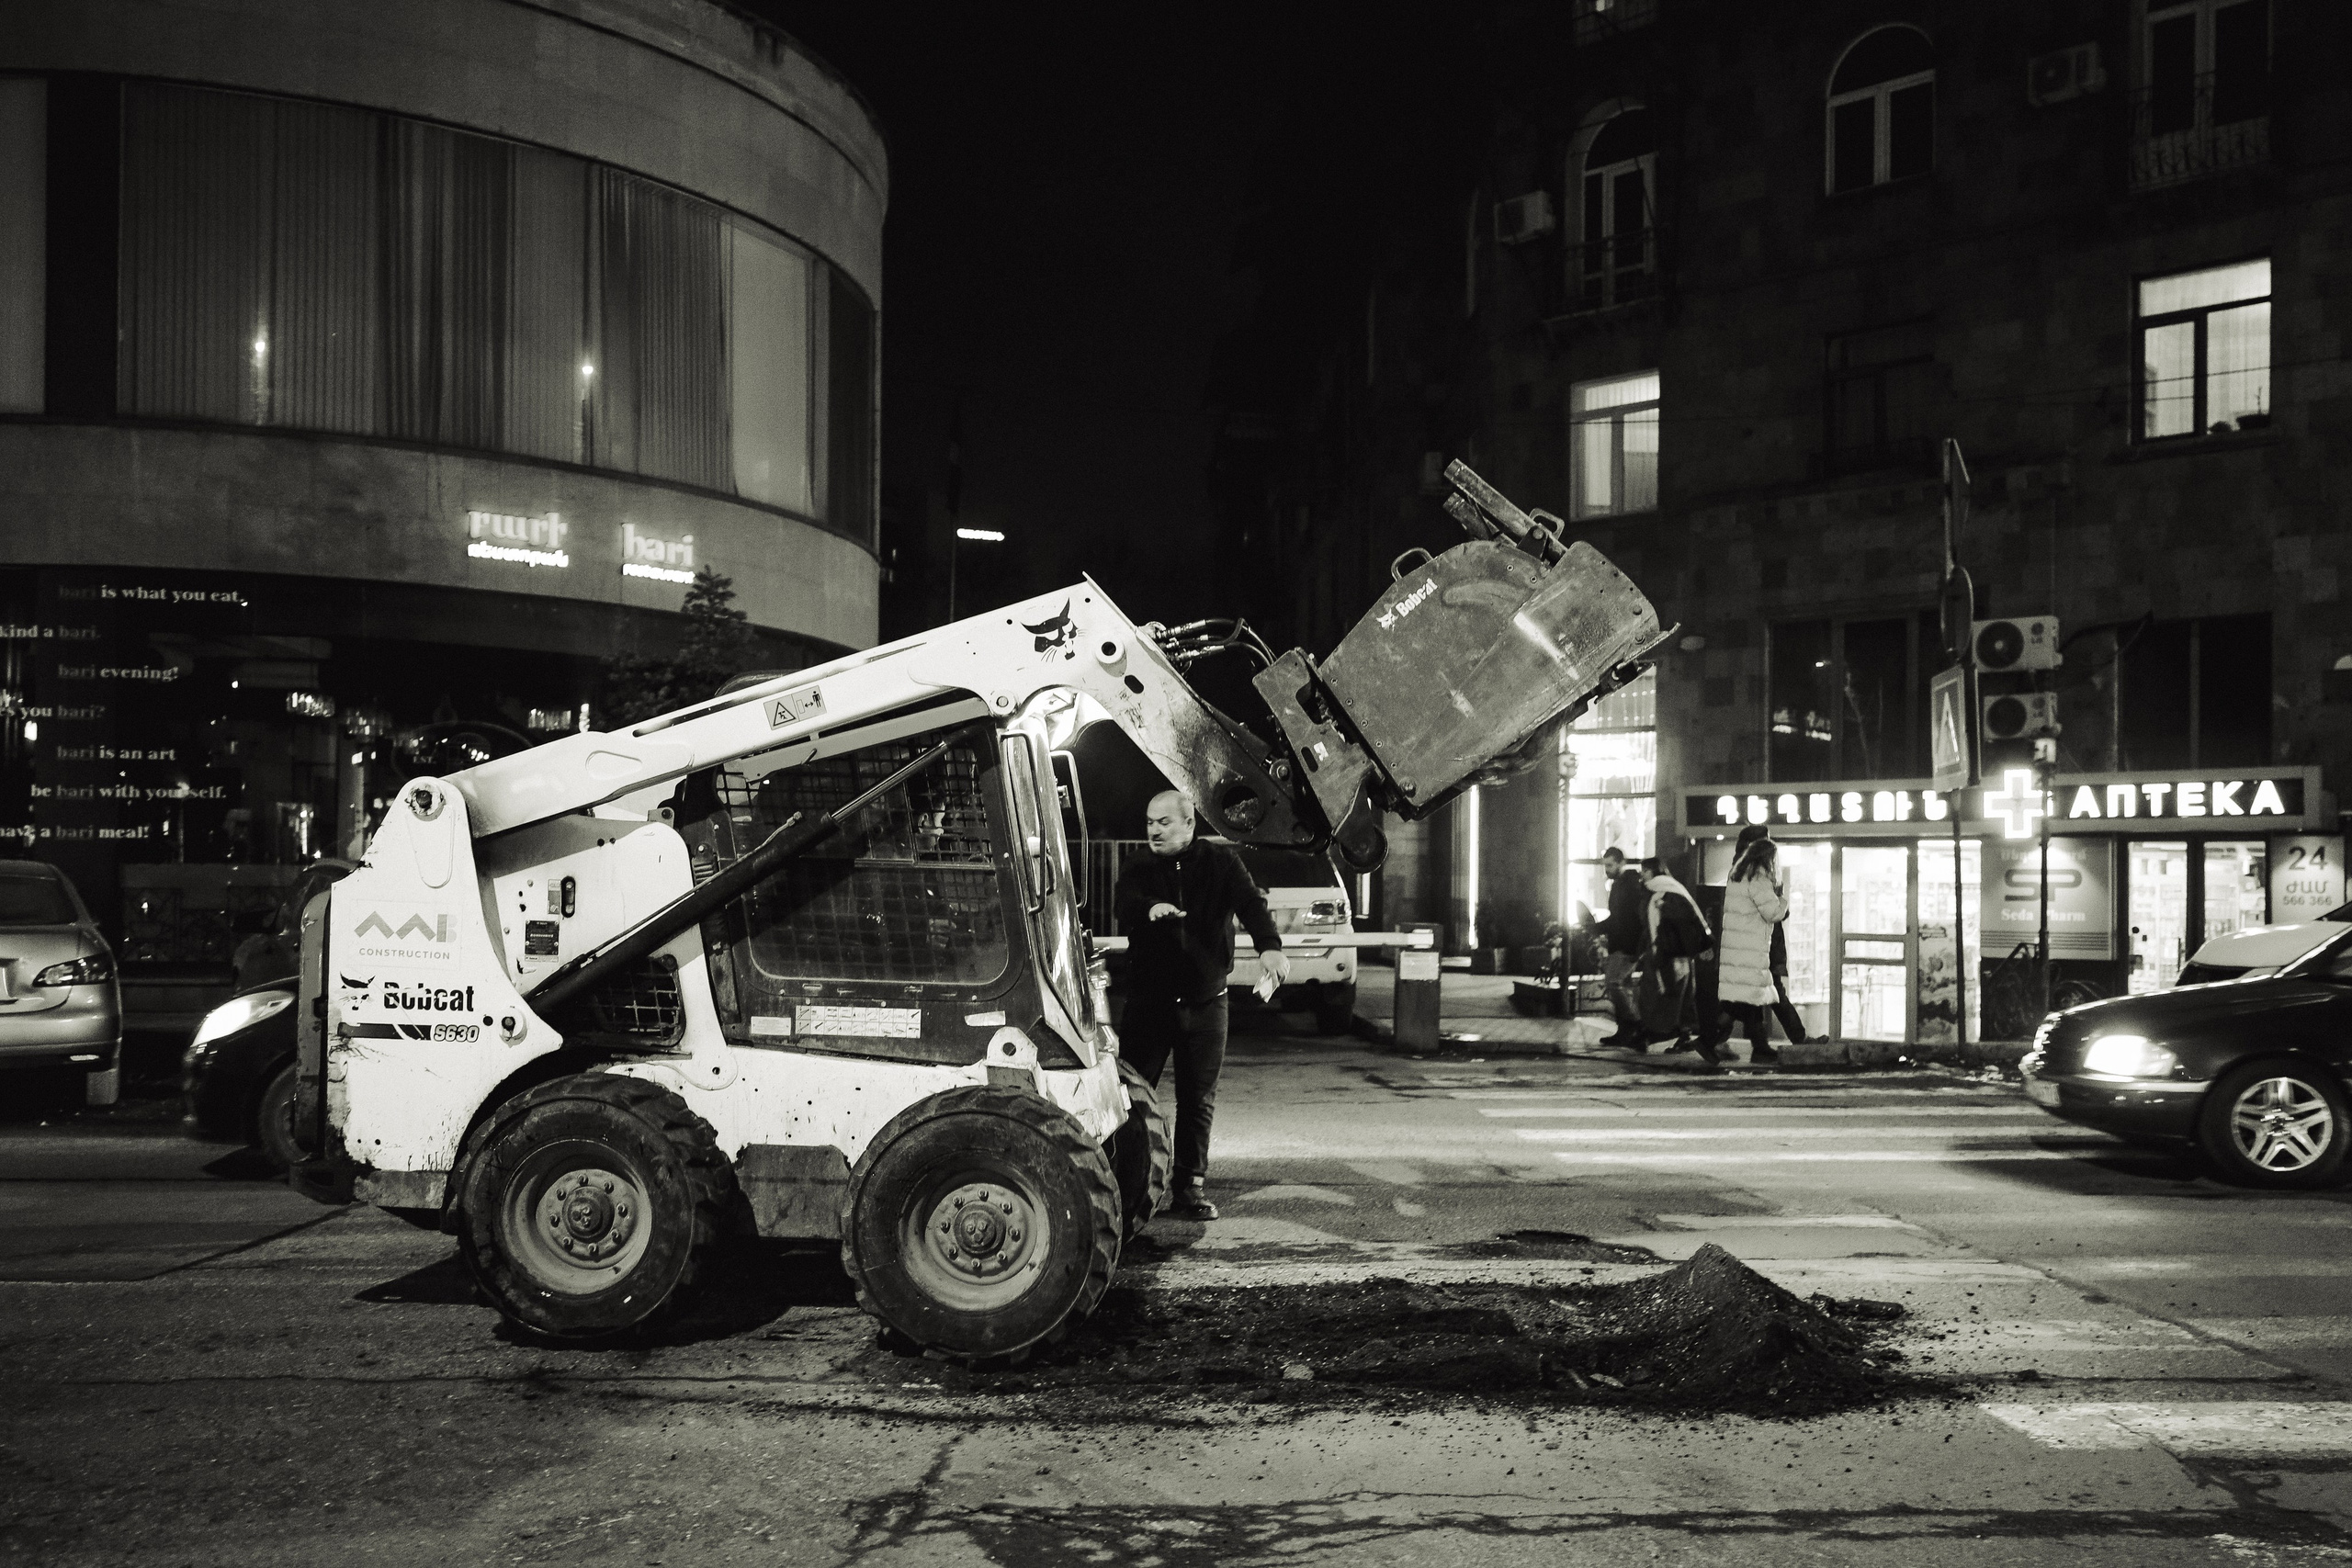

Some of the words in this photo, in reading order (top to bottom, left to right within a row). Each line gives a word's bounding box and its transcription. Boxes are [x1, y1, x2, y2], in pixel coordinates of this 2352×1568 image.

[622, 523, 694, 567] bari
[100, 584, 117, 598] is
[121, 586, 166, 599] what
[172, 591, 205, 603] you
[1395, 578, 1439, 617] Bobcat
[43, 628, 53, 638] a
[58, 664, 95, 678] bari
[100, 665, 179, 682] evening!
[20, 706, 52, 719] you
[57, 745, 94, 759] bari
[99, 745, 115, 759] is
[119, 749, 142, 760] an
[147, 748, 175, 761] art
[31, 784, 51, 797] be
[56, 784, 94, 798] bari
[99, 784, 140, 798] with
[2070, 780, 2286, 819] АПТЕКА
[40, 827, 51, 838] a
[56, 825, 94, 839] bari
[99, 825, 150, 839] meal!
[2289, 846, 2328, 870] 24
[358, 947, 450, 961] CONSTRUCTION
[384, 982, 474, 1011] Bobcat
[434, 1023, 480, 1043] S630
